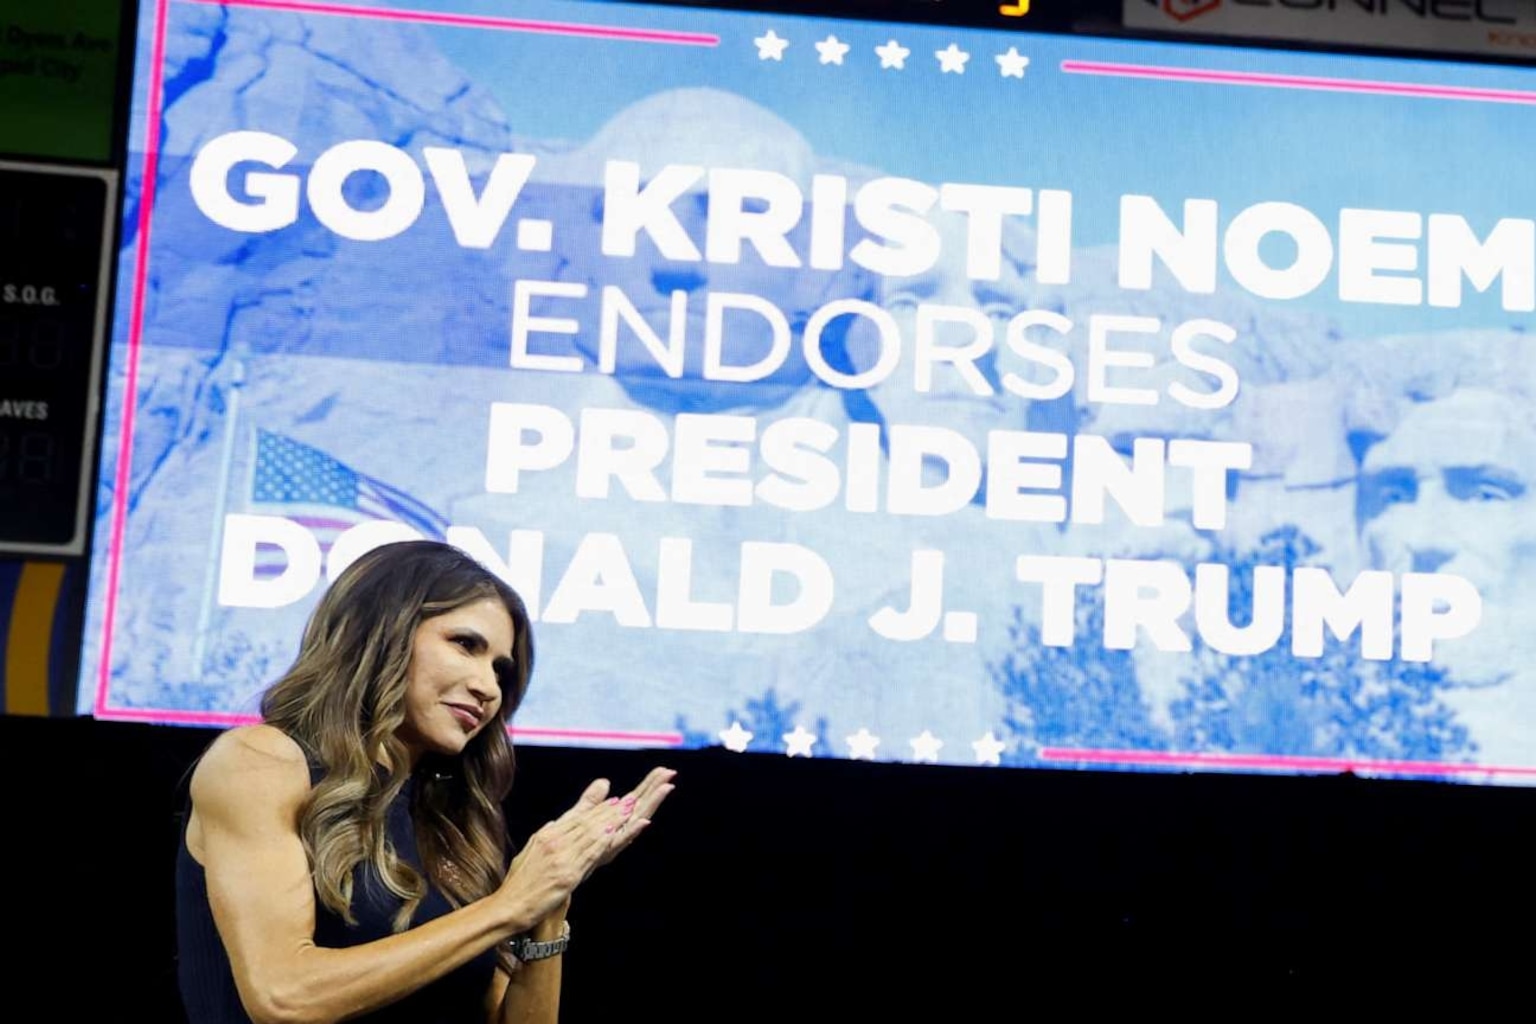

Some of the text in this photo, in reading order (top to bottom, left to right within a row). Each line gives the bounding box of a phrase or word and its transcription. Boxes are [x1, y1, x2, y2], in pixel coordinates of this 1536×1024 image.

[190, 131, 1536, 312] GOV. KRISTI NOEM
[3, 283, 60, 306] S.O.G.
[509, 279, 1240, 410] ENDORSES
[0, 399, 49, 421] AVES
[485, 403, 1252, 530] PRESIDENT
[867, 550, 978, 643] J.
[1016, 556, 1482, 662] TRUMP
